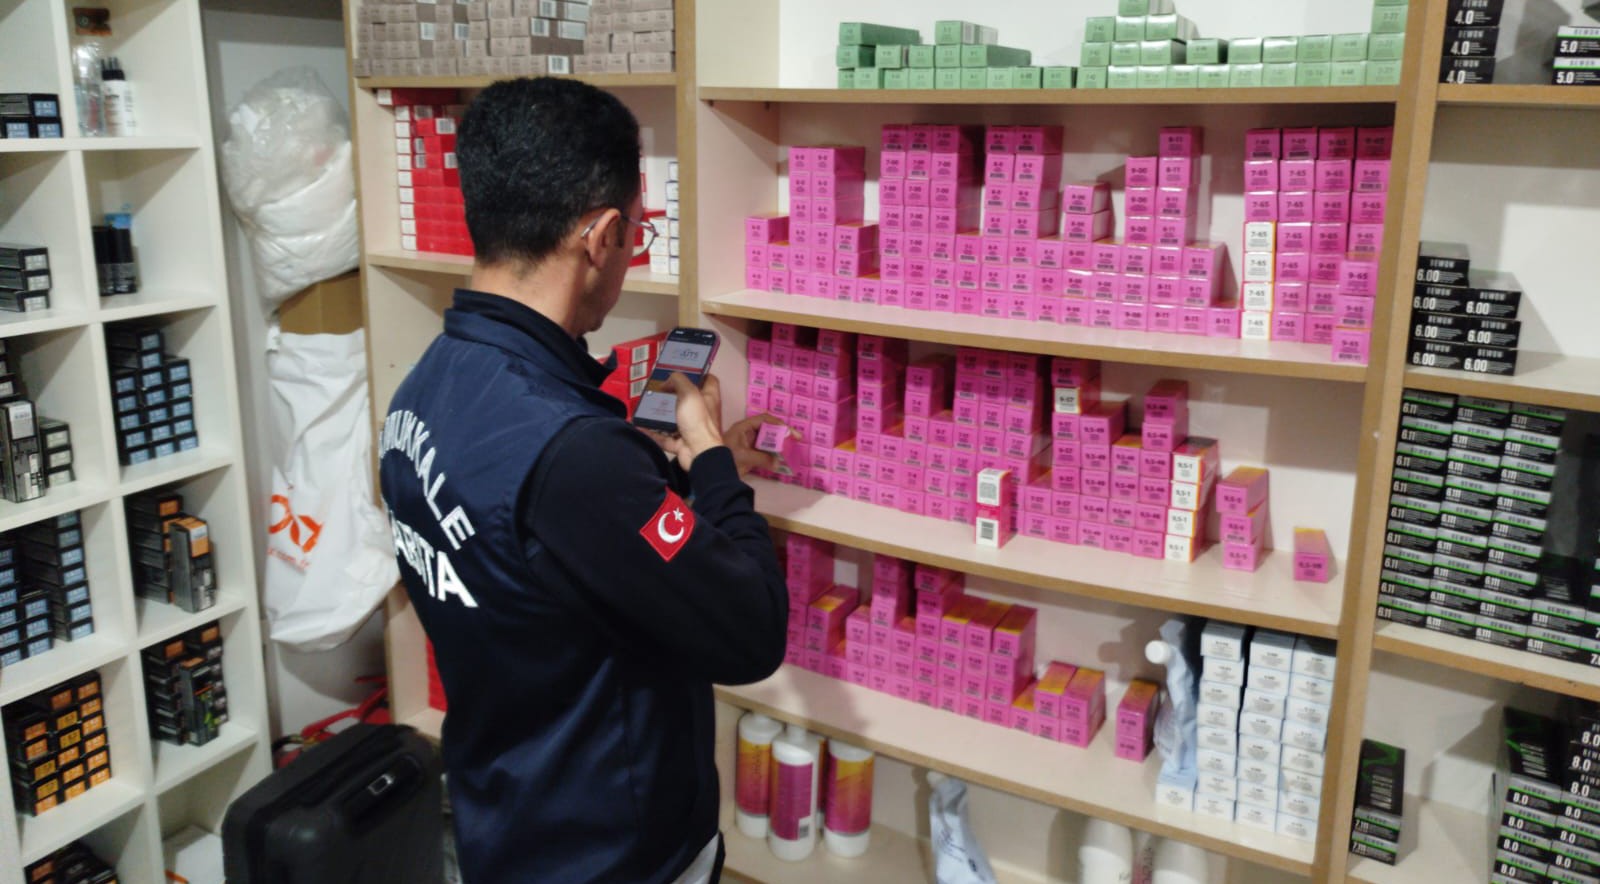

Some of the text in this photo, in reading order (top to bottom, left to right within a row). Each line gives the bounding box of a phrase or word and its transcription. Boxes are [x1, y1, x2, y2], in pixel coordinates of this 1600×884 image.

[1454, 10, 1474, 25] 4.0
[1450, 40, 1470, 55] 4.0
[1559, 40, 1579, 53] 5.0
[1446, 70, 1466, 84] 4.0
[1556, 71, 1575, 84] 5.0
[1416, 268, 1440, 282] 6.00
[1413, 296, 1436, 310] 6.00
[1466, 301, 1490, 315] 6.00
[1415, 324, 1438, 339] 6.00
[1467, 330, 1492, 344] 6.00
[1412, 351, 1436, 366] 6.00
[1464, 358, 1488, 372] 6.00
[1582, 731, 1600, 747] 8.0
[1572, 755, 1592, 772] 8.0
[1571, 781, 1590, 797] 8.0
[1513, 792, 1529, 805] 8.0
[1565, 805, 1581, 819] 8.0
[1508, 816, 1524, 829] 8.0
[1560, 830, 1576, 844] 8.0
[1503, 838, 1519, 852] 8.0
[1555, 854, 1571, 868] 8.0
[1500, 863, 1516, 877] 8.0
